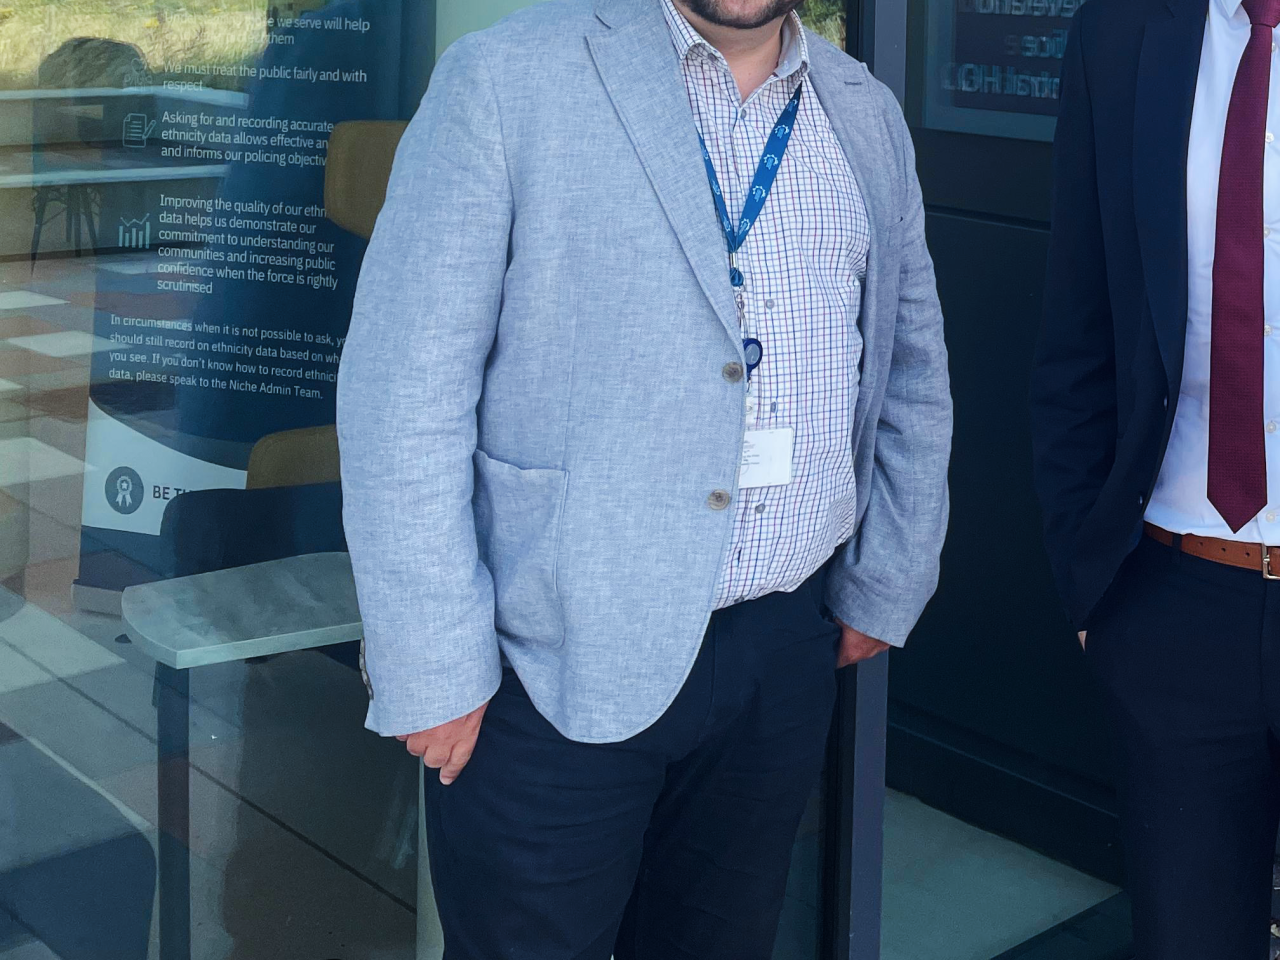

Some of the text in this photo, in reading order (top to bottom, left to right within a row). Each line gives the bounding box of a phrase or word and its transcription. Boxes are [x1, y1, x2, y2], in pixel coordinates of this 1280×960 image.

[277, 18, 292, 28] we
[294, 20, 321, 29] serve
[324, 18, 342, 30] will
[345, 18, 370, 33] help
[267, 32, 295, 45] them
[164, 64, 367, 83] We must treat the public fairly and with
[163, 79, 203, 92] respect
[162, 111, 334, 133] Asking for and recording accurate
[162, 128, 328, 149] ethnicity data allows effective an
[161, 145, 326, 167] and informs our policing objectiv
[160, 194, 327, 218] Improving the quality of our ethn
[159, 211, 316, 234] data helps us demonstrate our
[159, 229, 335, 254] commitment to understanding our
[158, 246, 335, 271] communities and increasing public
[157, 279, 213, 294] scrutinised
[158, 262, 338, 290] confidence when the force is rightly
[111, 314, 346, 348] In circumstances when it is not possible to ask, yo
[110, 332, 340, 364] should still record on ethnicity data based on wh
[109, 351, 127, 363] you
[129, 353, 149, 363] see.
[152, 353, 160, 364] If
[162, 355, 179, 368] you
[207, 358, 233, 371] know
[235, 361, 256, 373] how
[259, 364, 269, 375] to
[271, 366, 302, 378] record
[305, 369, 337, 382] ethnici
[109, 369, 323, 399] data, please speak to the Niche Admin Team.
[153, 485, 170, 500] BE
